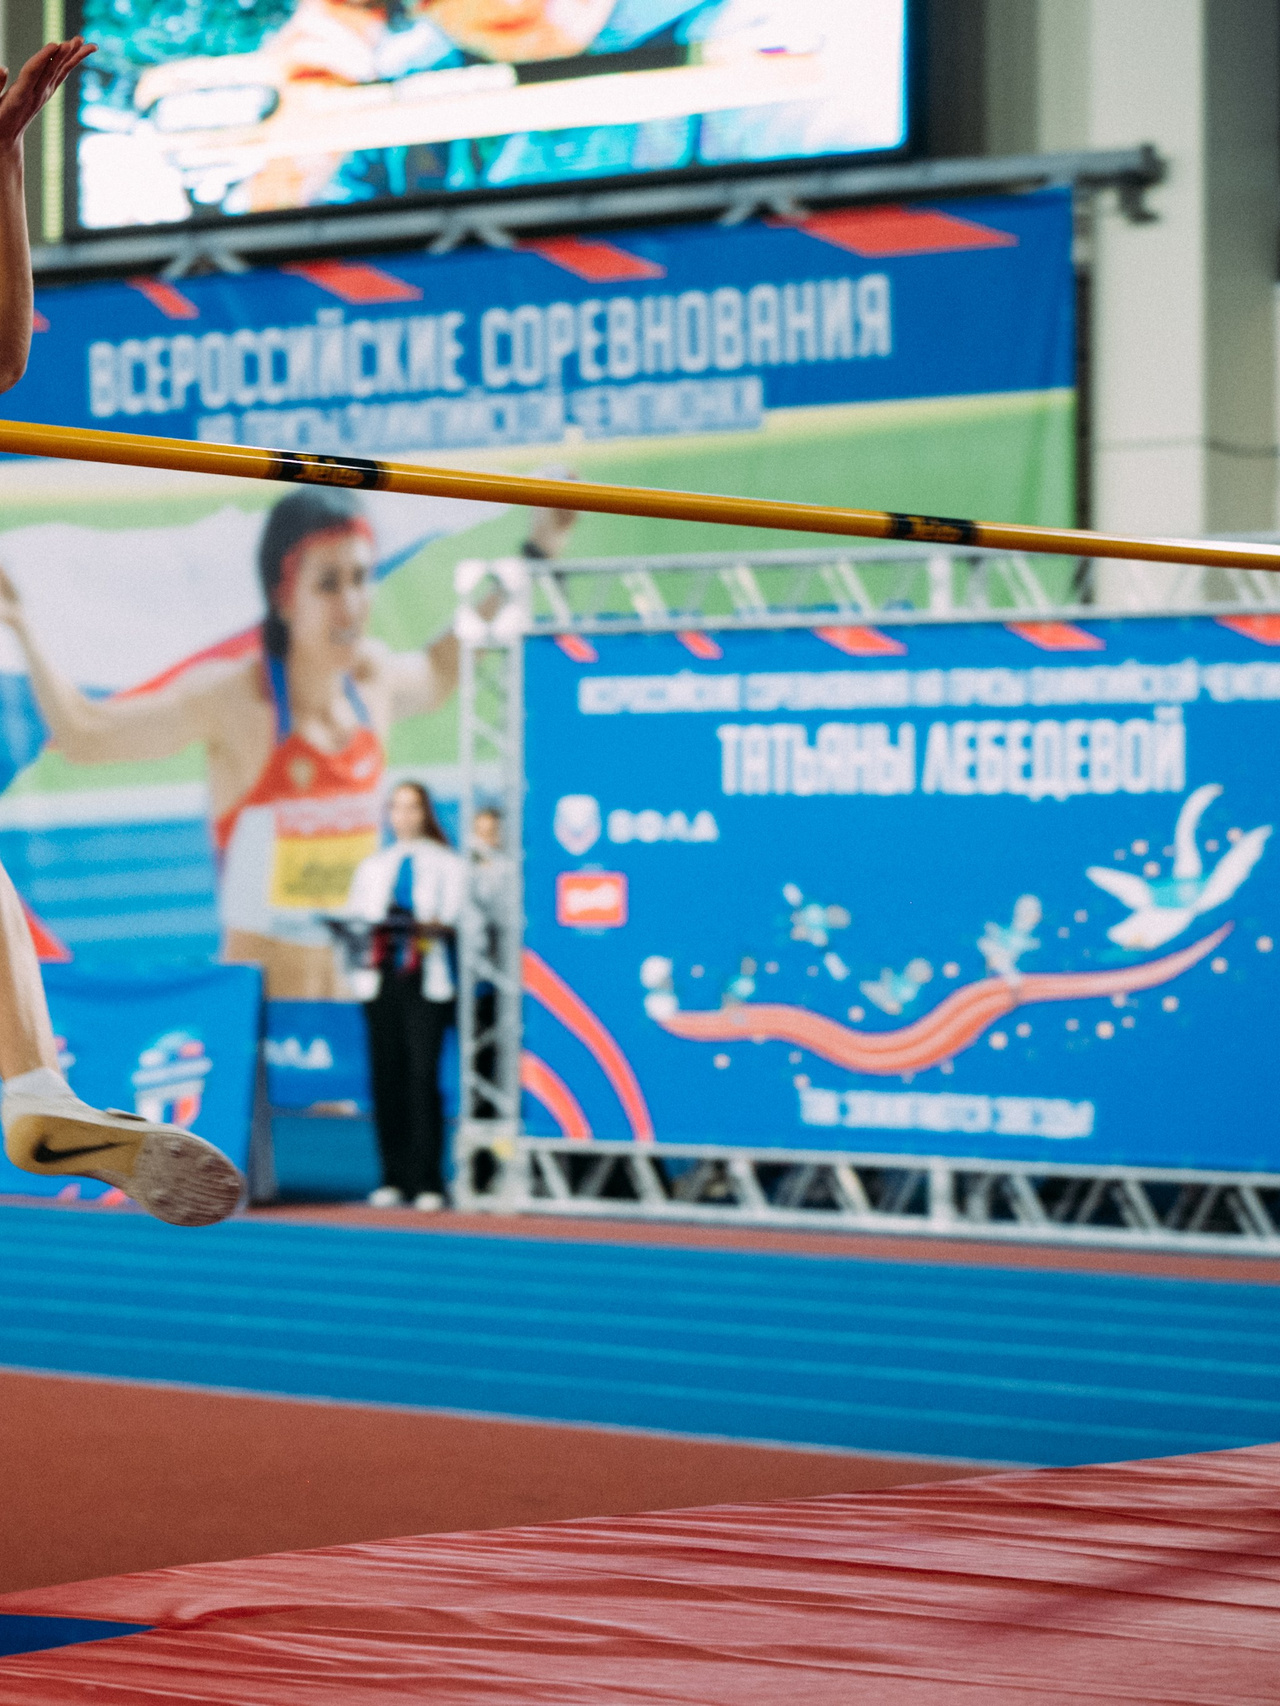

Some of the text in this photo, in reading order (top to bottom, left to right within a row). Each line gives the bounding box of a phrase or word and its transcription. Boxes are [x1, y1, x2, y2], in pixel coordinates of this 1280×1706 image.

[89, 273, 892, 417] ВСЕРОССИЙСКИЕ СОРЕВНОВАНИЯ
[716, 705, 1187, 802] ТАТЬЯНЫ ЛЕБЕДЕВОЙ
